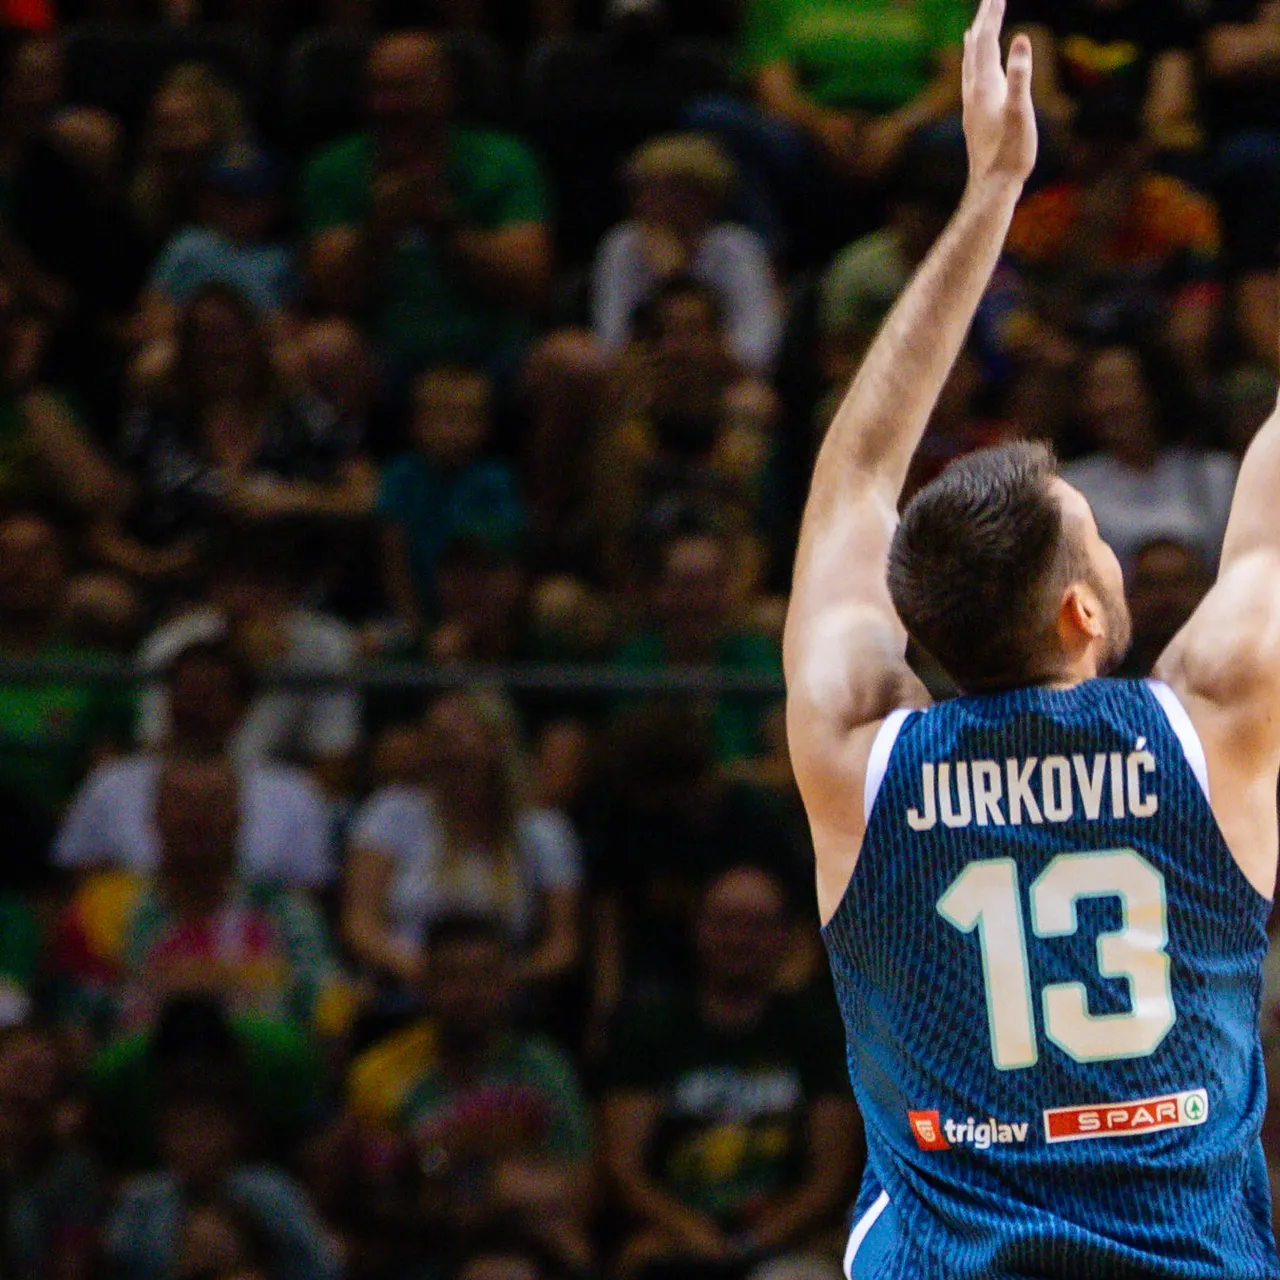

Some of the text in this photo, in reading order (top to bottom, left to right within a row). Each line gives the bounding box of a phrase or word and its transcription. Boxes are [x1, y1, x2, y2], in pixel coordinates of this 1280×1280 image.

[907, 738, 1159, 831] JURKOVIĆ
[936, 848, 1177, 1071] 13
[944, 1117, 1029, 1149] triglav
[1078, 1101, 1178, 1131] SPAR
